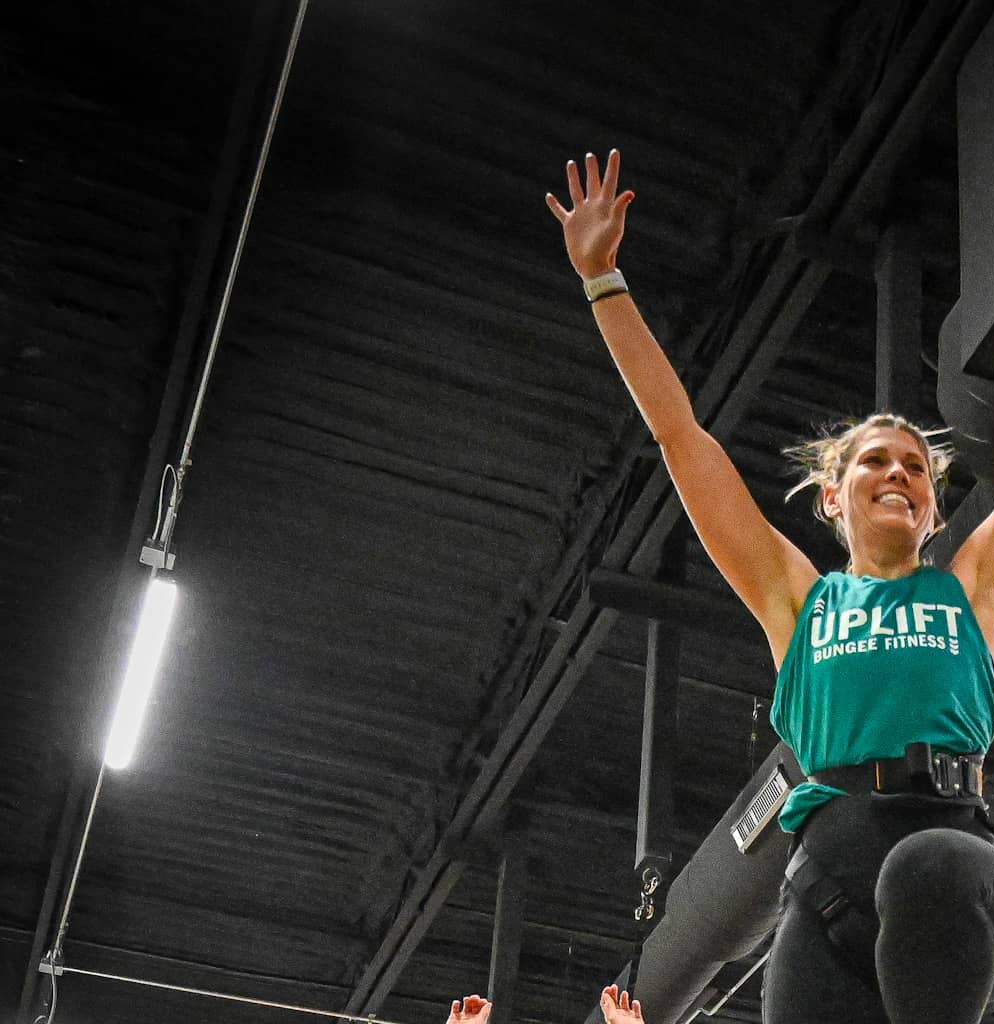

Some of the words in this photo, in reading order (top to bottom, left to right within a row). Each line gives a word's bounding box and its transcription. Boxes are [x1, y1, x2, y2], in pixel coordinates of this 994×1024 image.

[810, 603, 963, 649] UPLIFT
[813, 639, 878, 664] BUNGEE
[884, 634, 946, 650] FITNESS
